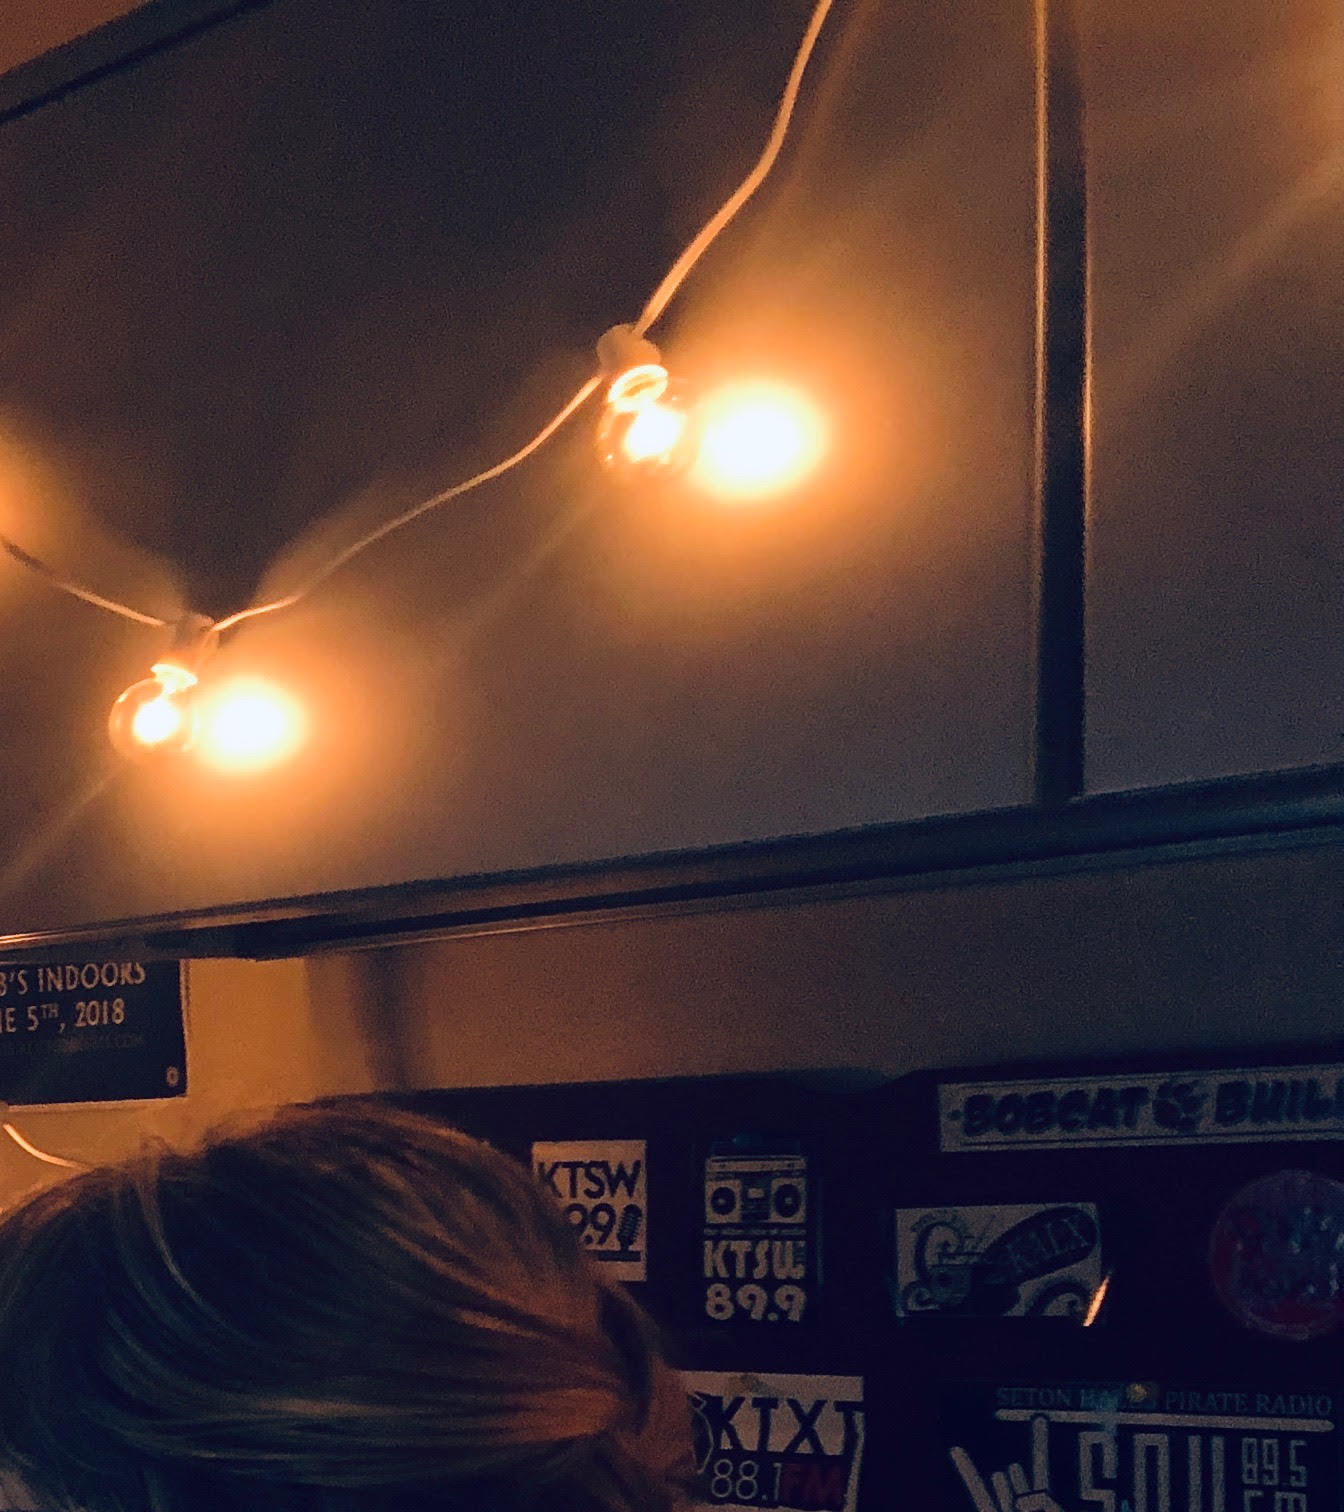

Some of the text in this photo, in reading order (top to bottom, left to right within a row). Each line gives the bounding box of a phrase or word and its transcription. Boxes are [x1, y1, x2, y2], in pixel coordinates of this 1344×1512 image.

[37, 961, 147, 993] INDOORS
[75, 998, 126, 1028] 2018
[537, 1159, 642, 1199] KTSW
[705, 1283, 807, 1322] 89.9
[1164, 1390, 1252, 1413] PIRATE
[1255, 1392, 1334, 1417] RADIO
[712, 1459, 783, 1501] 88.1
